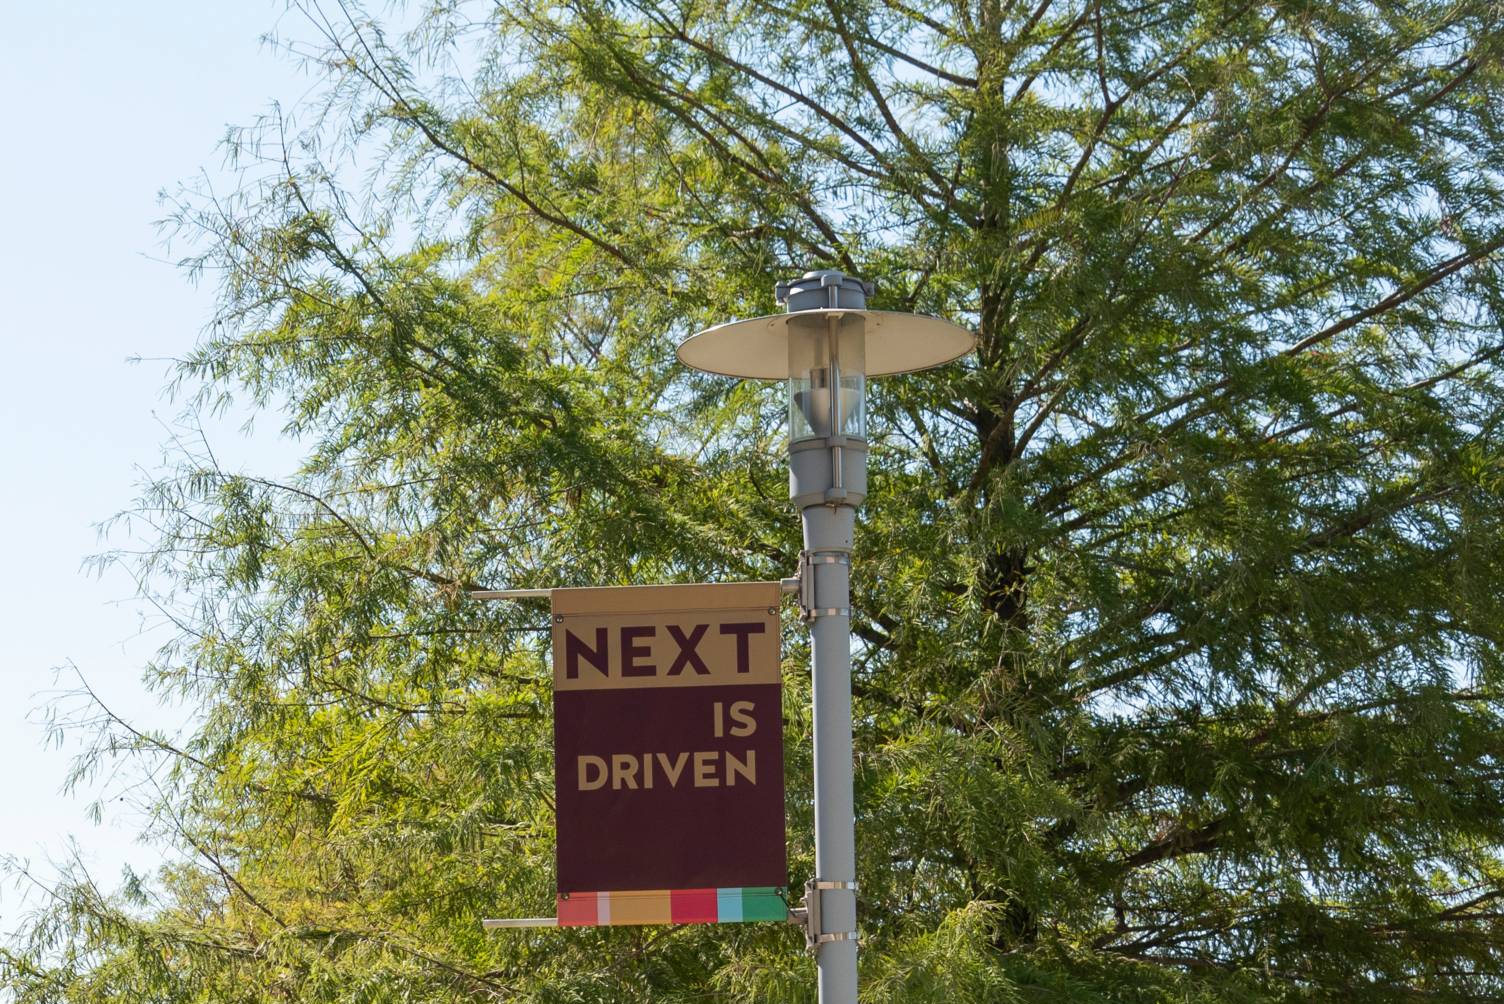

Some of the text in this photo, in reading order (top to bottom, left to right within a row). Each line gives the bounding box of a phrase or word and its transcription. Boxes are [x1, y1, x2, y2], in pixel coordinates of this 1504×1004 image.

[565, 622, 765, 679] NEXT
[713, 701, 757, 738] IS
[577, 749, 756, 791] DRIVEN
